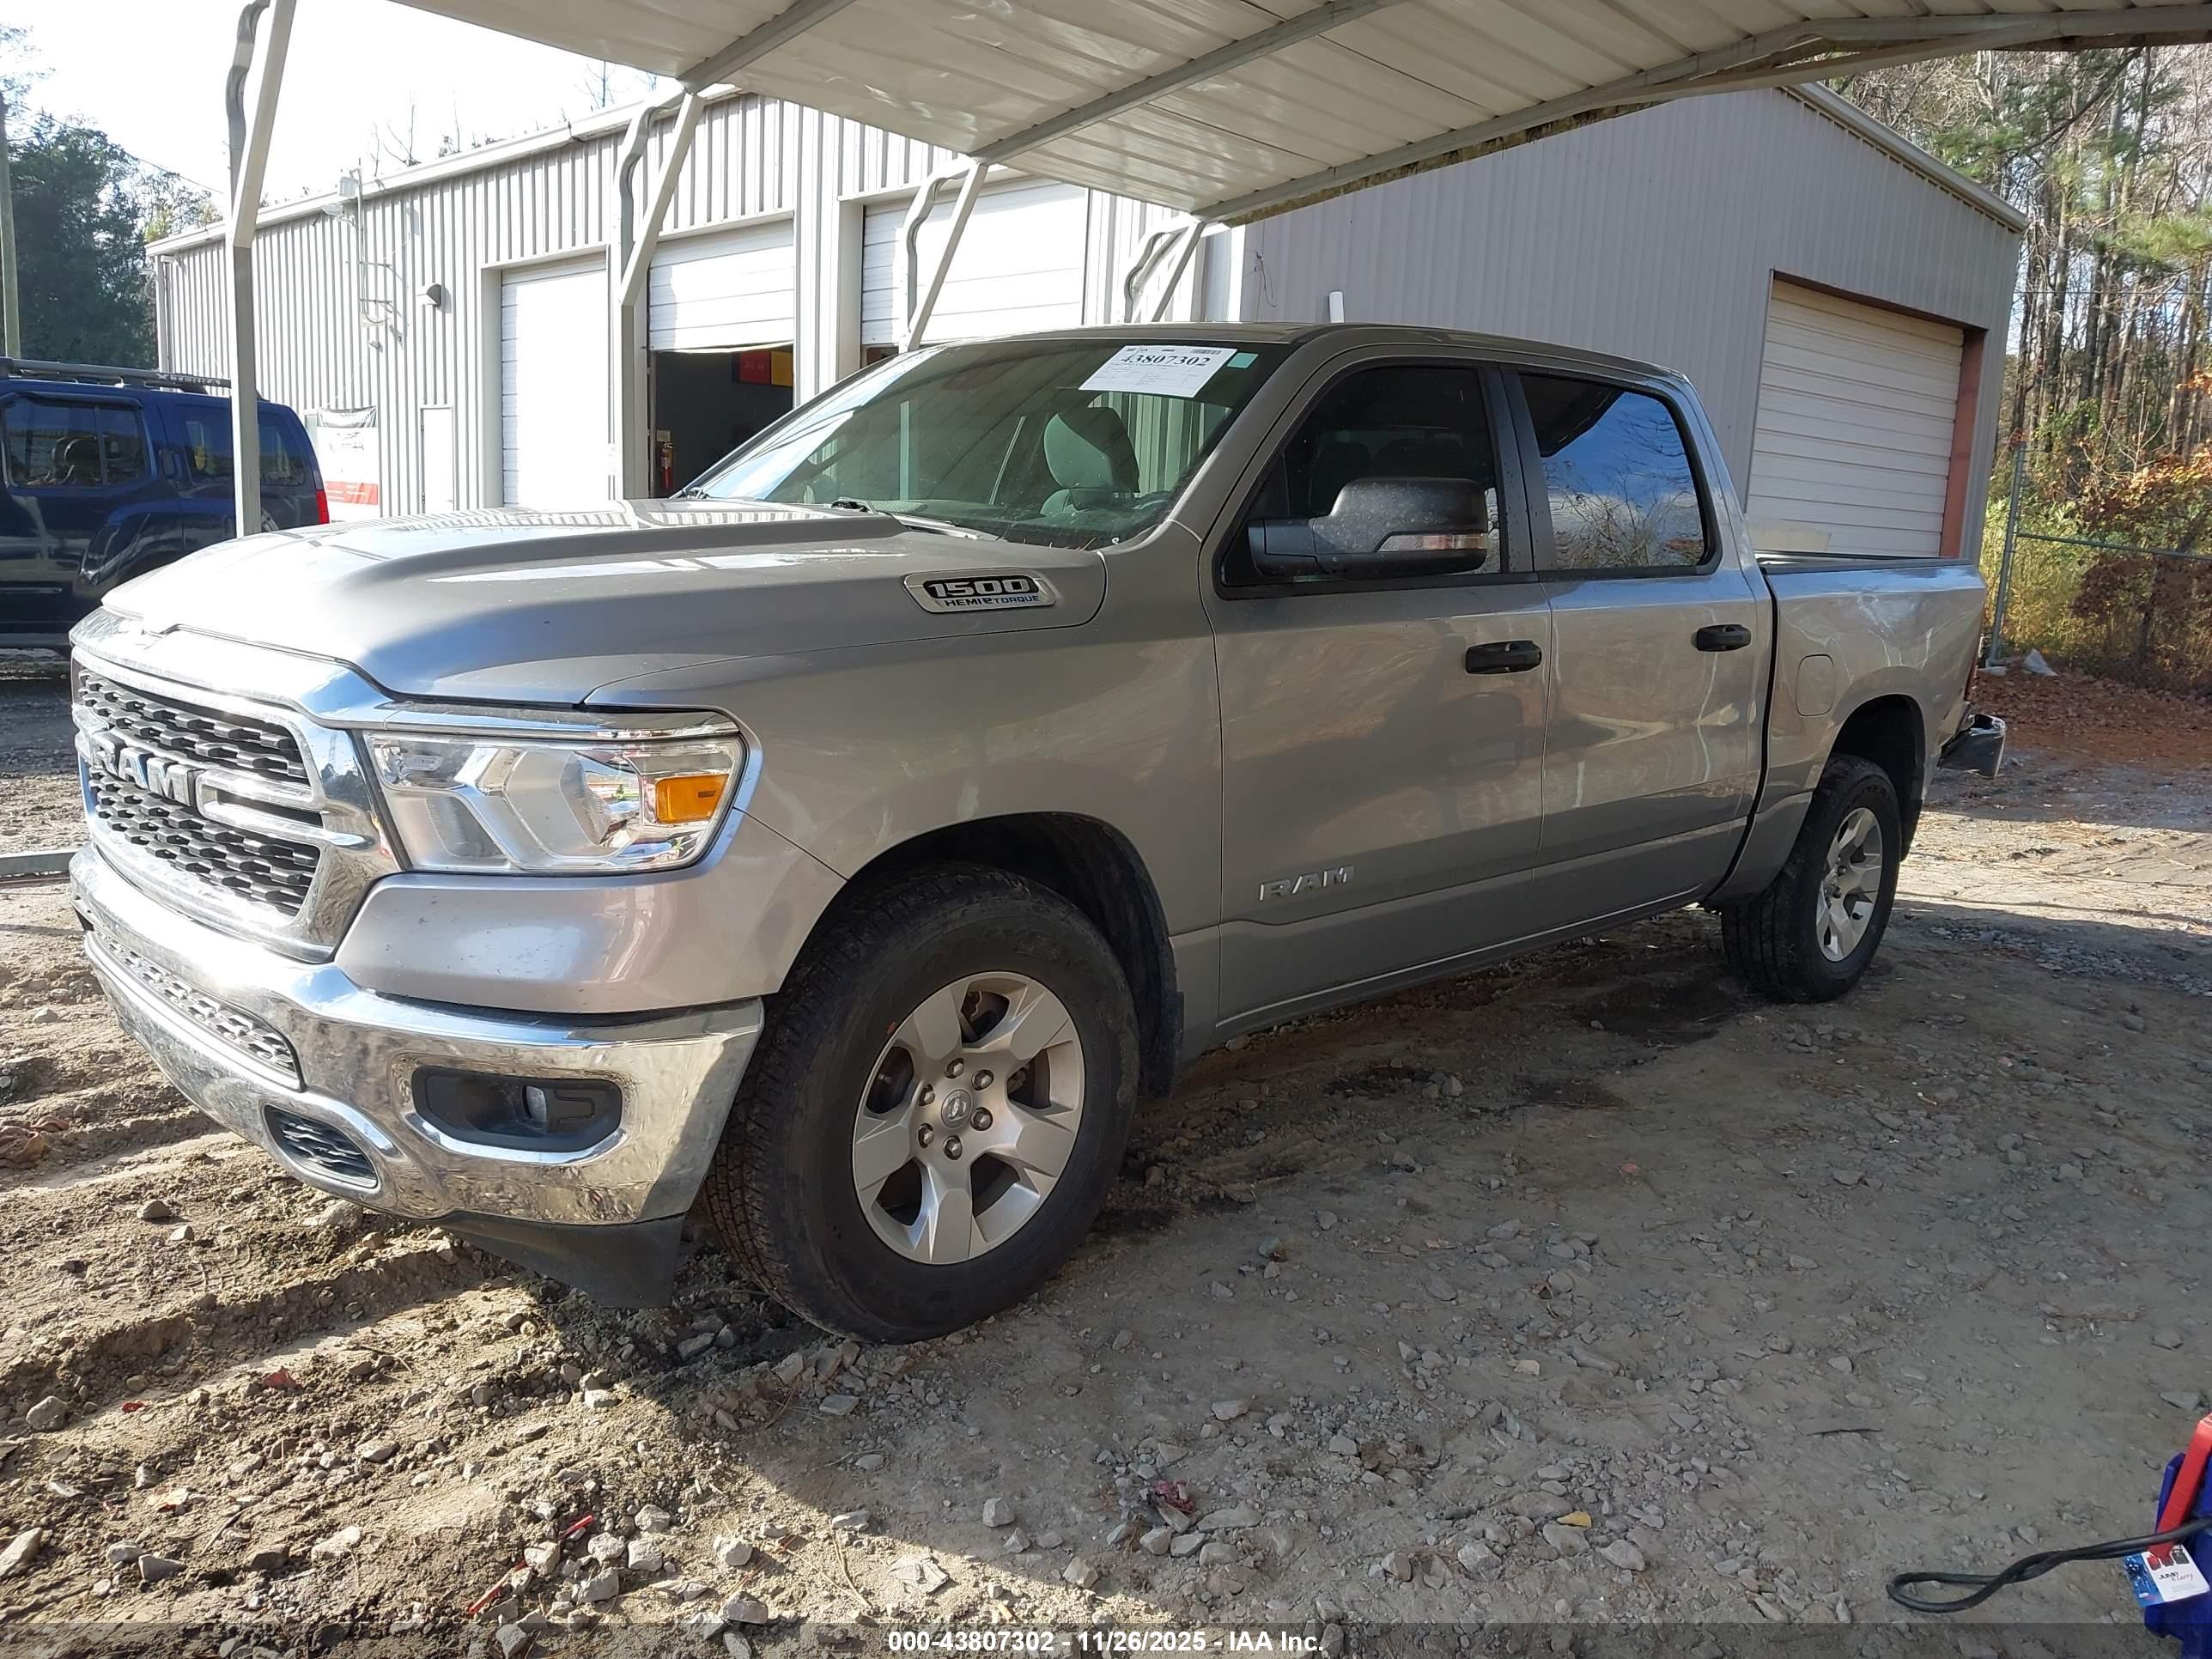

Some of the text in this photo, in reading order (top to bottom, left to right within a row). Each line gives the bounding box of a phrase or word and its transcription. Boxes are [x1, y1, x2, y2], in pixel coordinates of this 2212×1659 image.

[1120, 354, 1211, 367] 43807302
[929, 579, 1030, 598] 1500
[945, 599, 982, 607] HEMI
[92, 730, 194, 806] RAM
[1259, 865, 1354, 901] RAM
